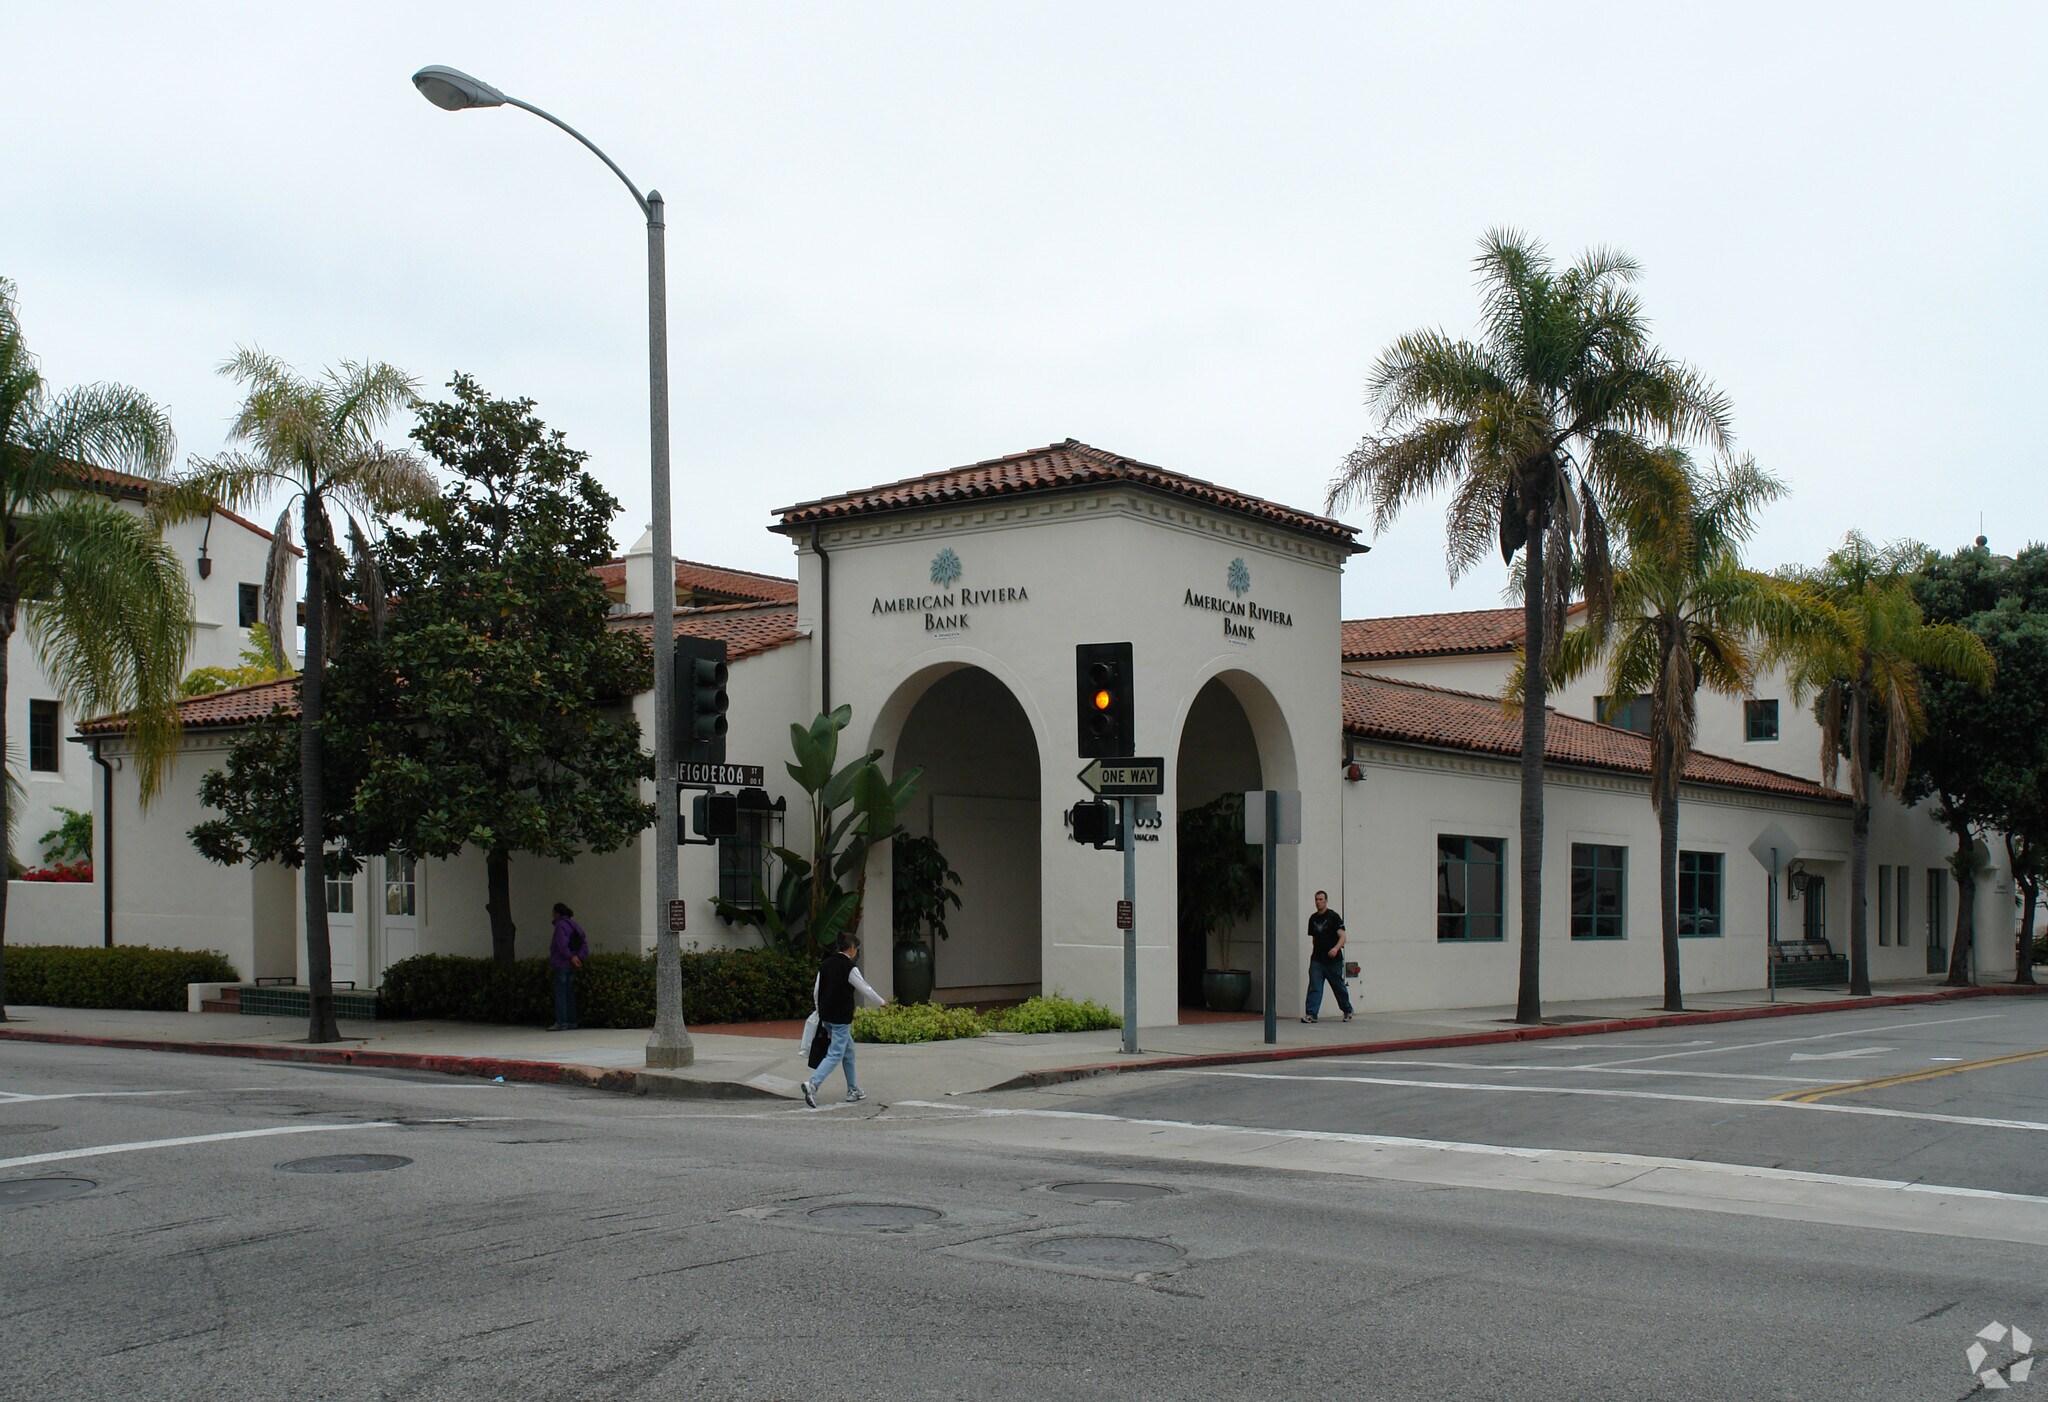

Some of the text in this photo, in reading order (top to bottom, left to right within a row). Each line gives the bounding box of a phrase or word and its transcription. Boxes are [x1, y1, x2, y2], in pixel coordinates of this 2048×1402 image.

[872, 586, 1028, 614] AMERICAN RIVIERA
[1184, 588, 1293, 626] AMERICAN RIVIERA
[925, 613, 969, 630] BANK
[1223, 617, 1255, 640] BANK
[679, 763, 744, 784] FIGUEROA
[1102, 769, 1155, 783] ONE WAY
